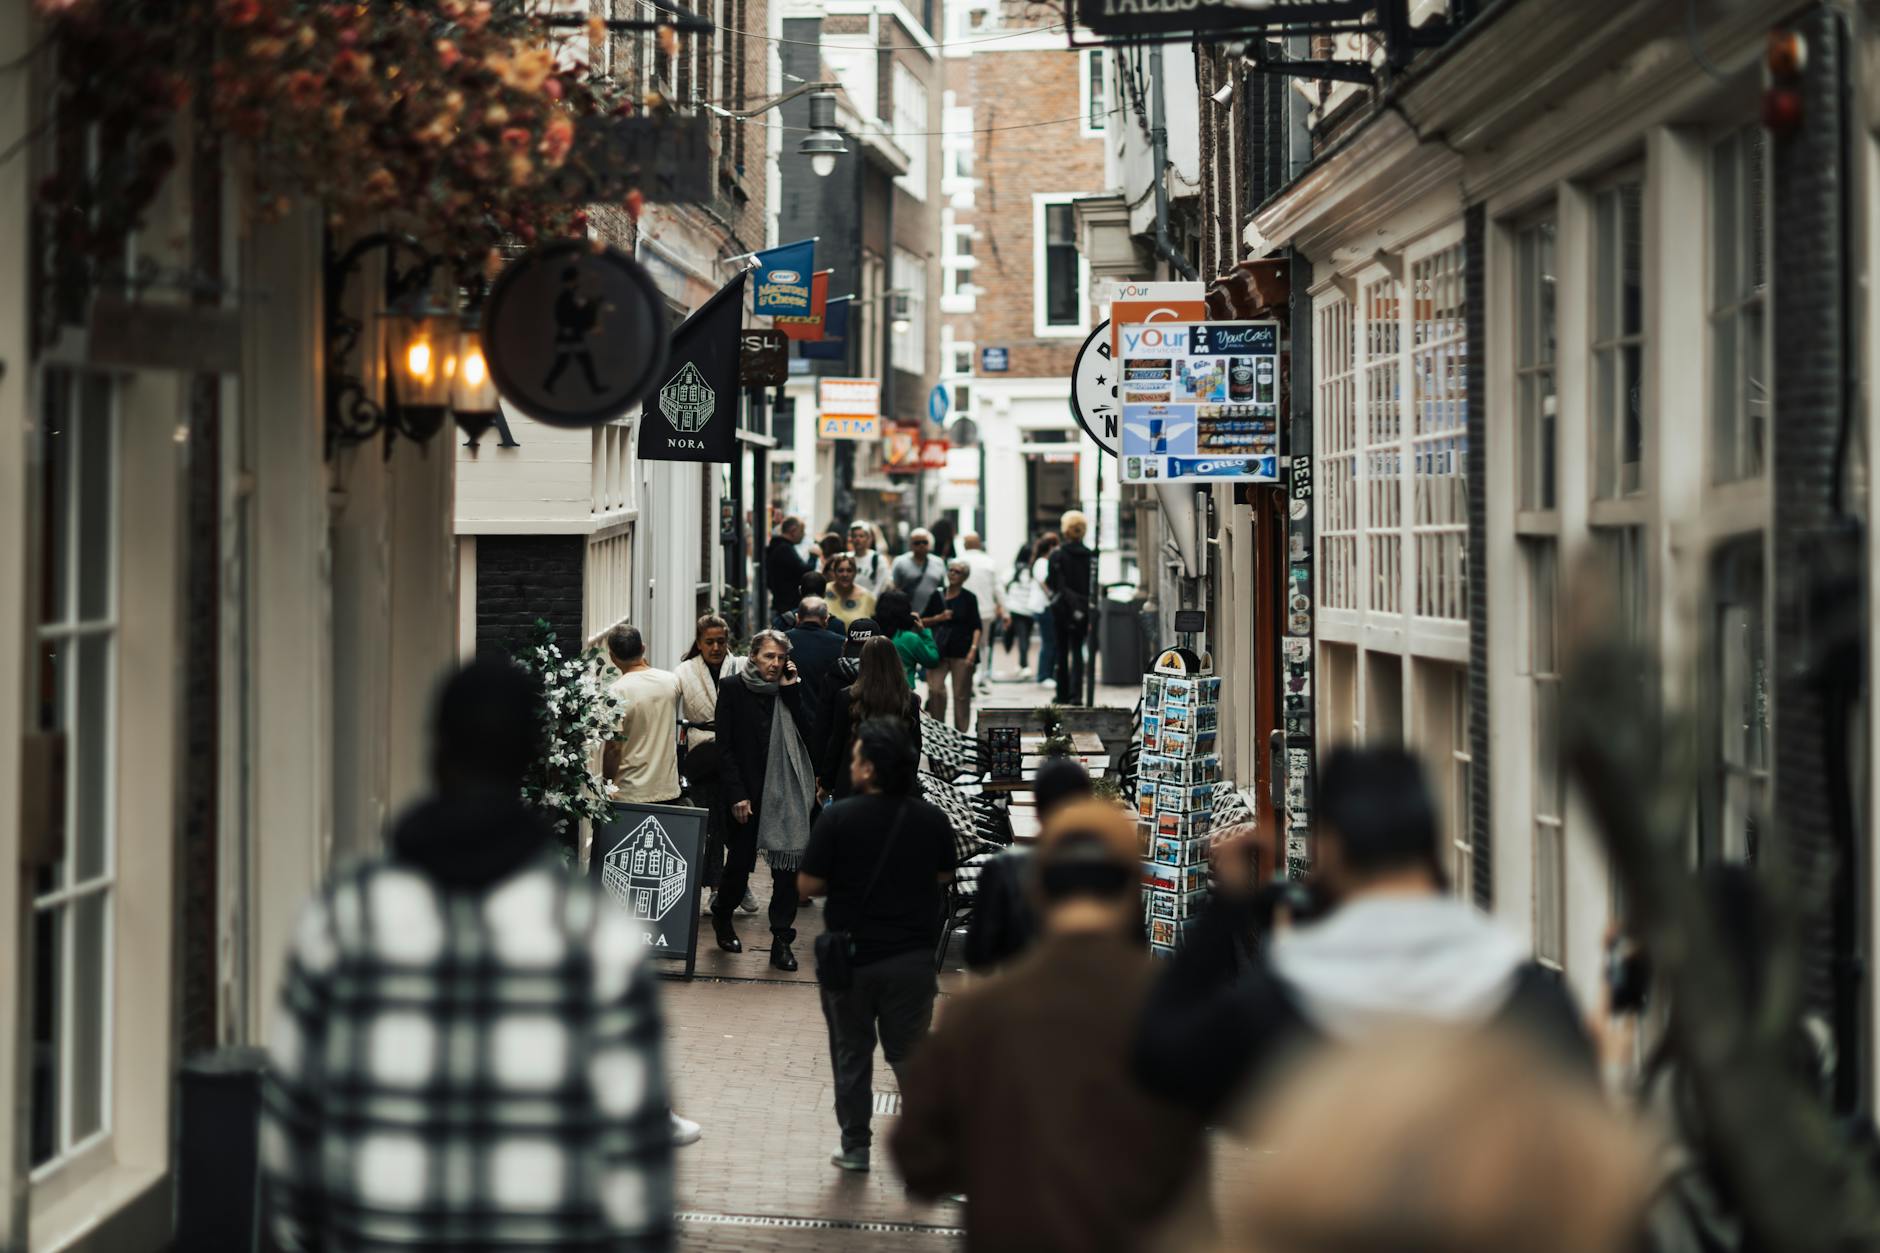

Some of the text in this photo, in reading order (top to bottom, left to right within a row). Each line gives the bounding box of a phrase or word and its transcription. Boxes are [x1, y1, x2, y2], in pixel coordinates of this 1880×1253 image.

[768, 292, 808, 307] Cheese
[1118, 285, 1149, 300] yOur
[1124, 328, 1188, 352] yOur
[825, 420, 874, 433] ATM
[667, 438, 705, 450] NORA
[1197, 458, 1245, 474] OREO
